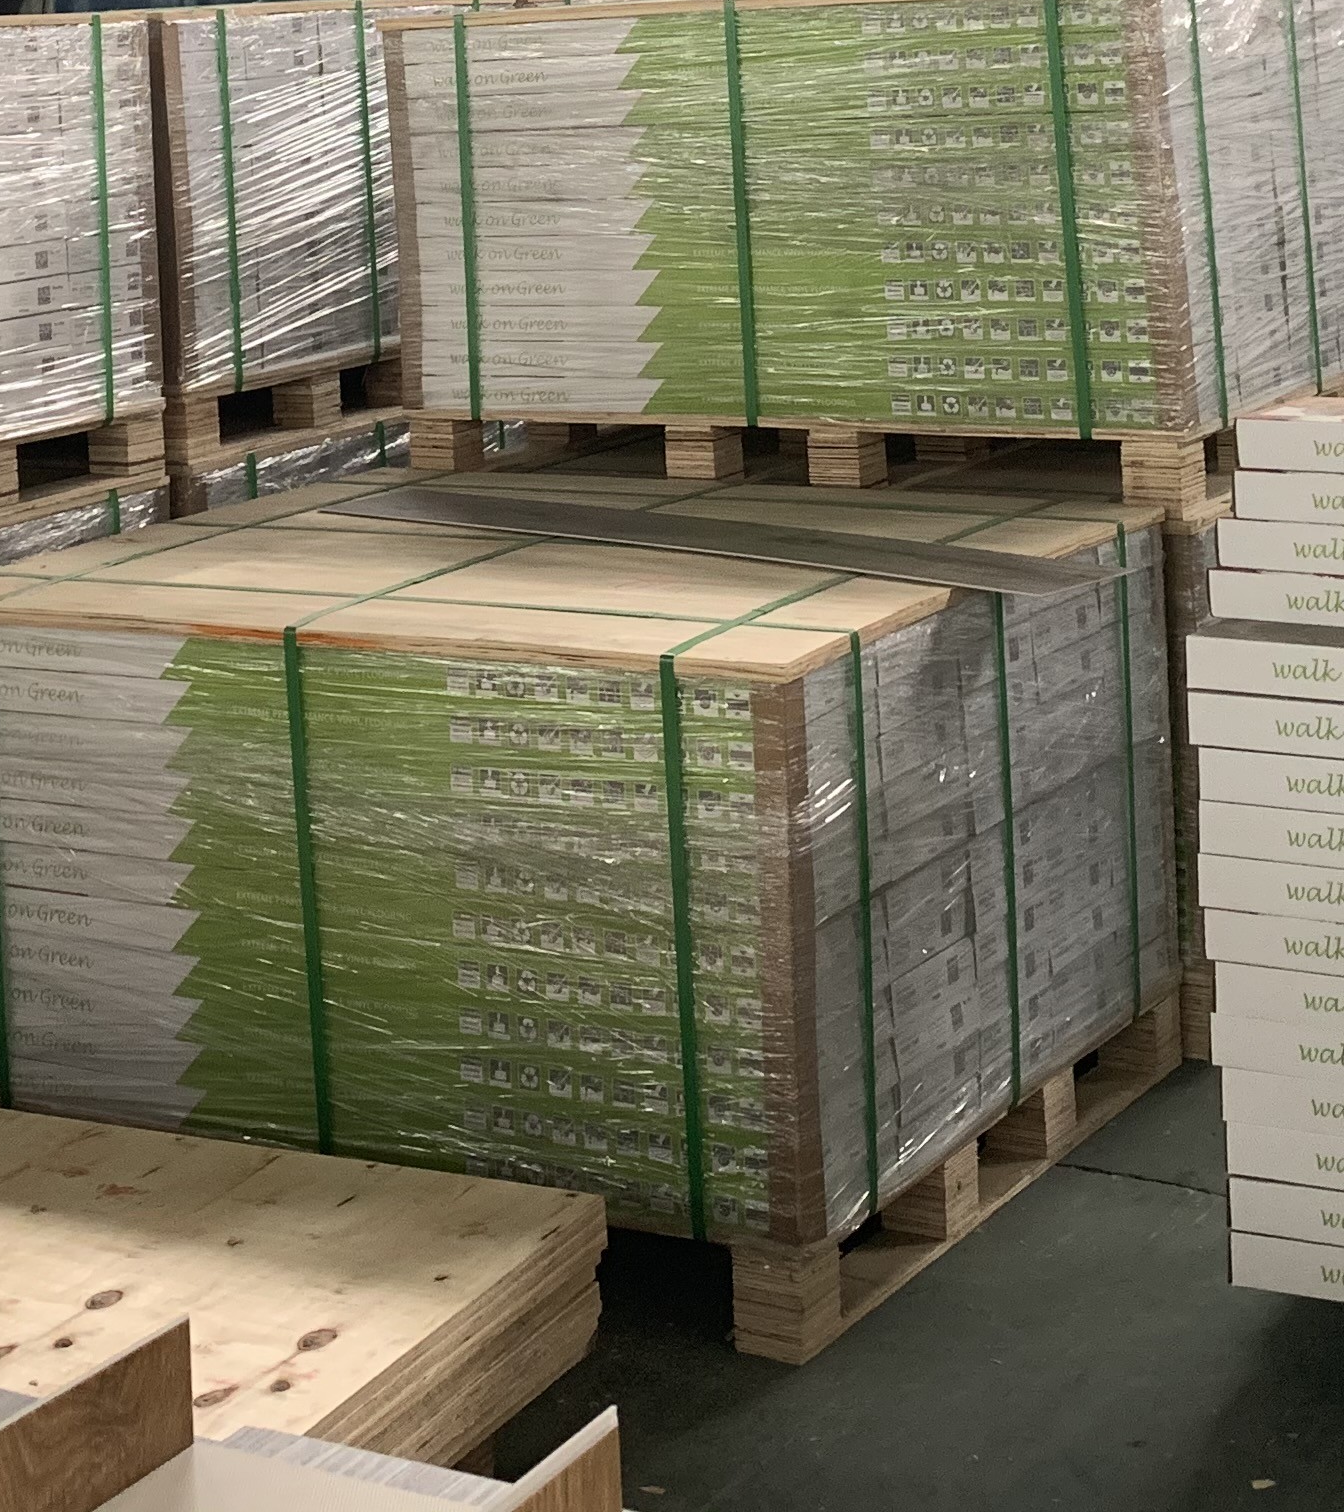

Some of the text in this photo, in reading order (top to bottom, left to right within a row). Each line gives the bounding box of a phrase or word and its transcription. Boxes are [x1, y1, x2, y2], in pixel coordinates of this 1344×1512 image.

[485, 214, 510, 226] on
[511, 211, 560, 227] Green
[493, 316, 518, 329] on
[519, 315, 568, 331] Green
[1272, 658, 1341, 682] walk
[1275, 716, 1344, 741] walk
[7, 904, 36, 919] on
[37, 905, 92, 927] Green
[38, 945, 94, 970] Green
